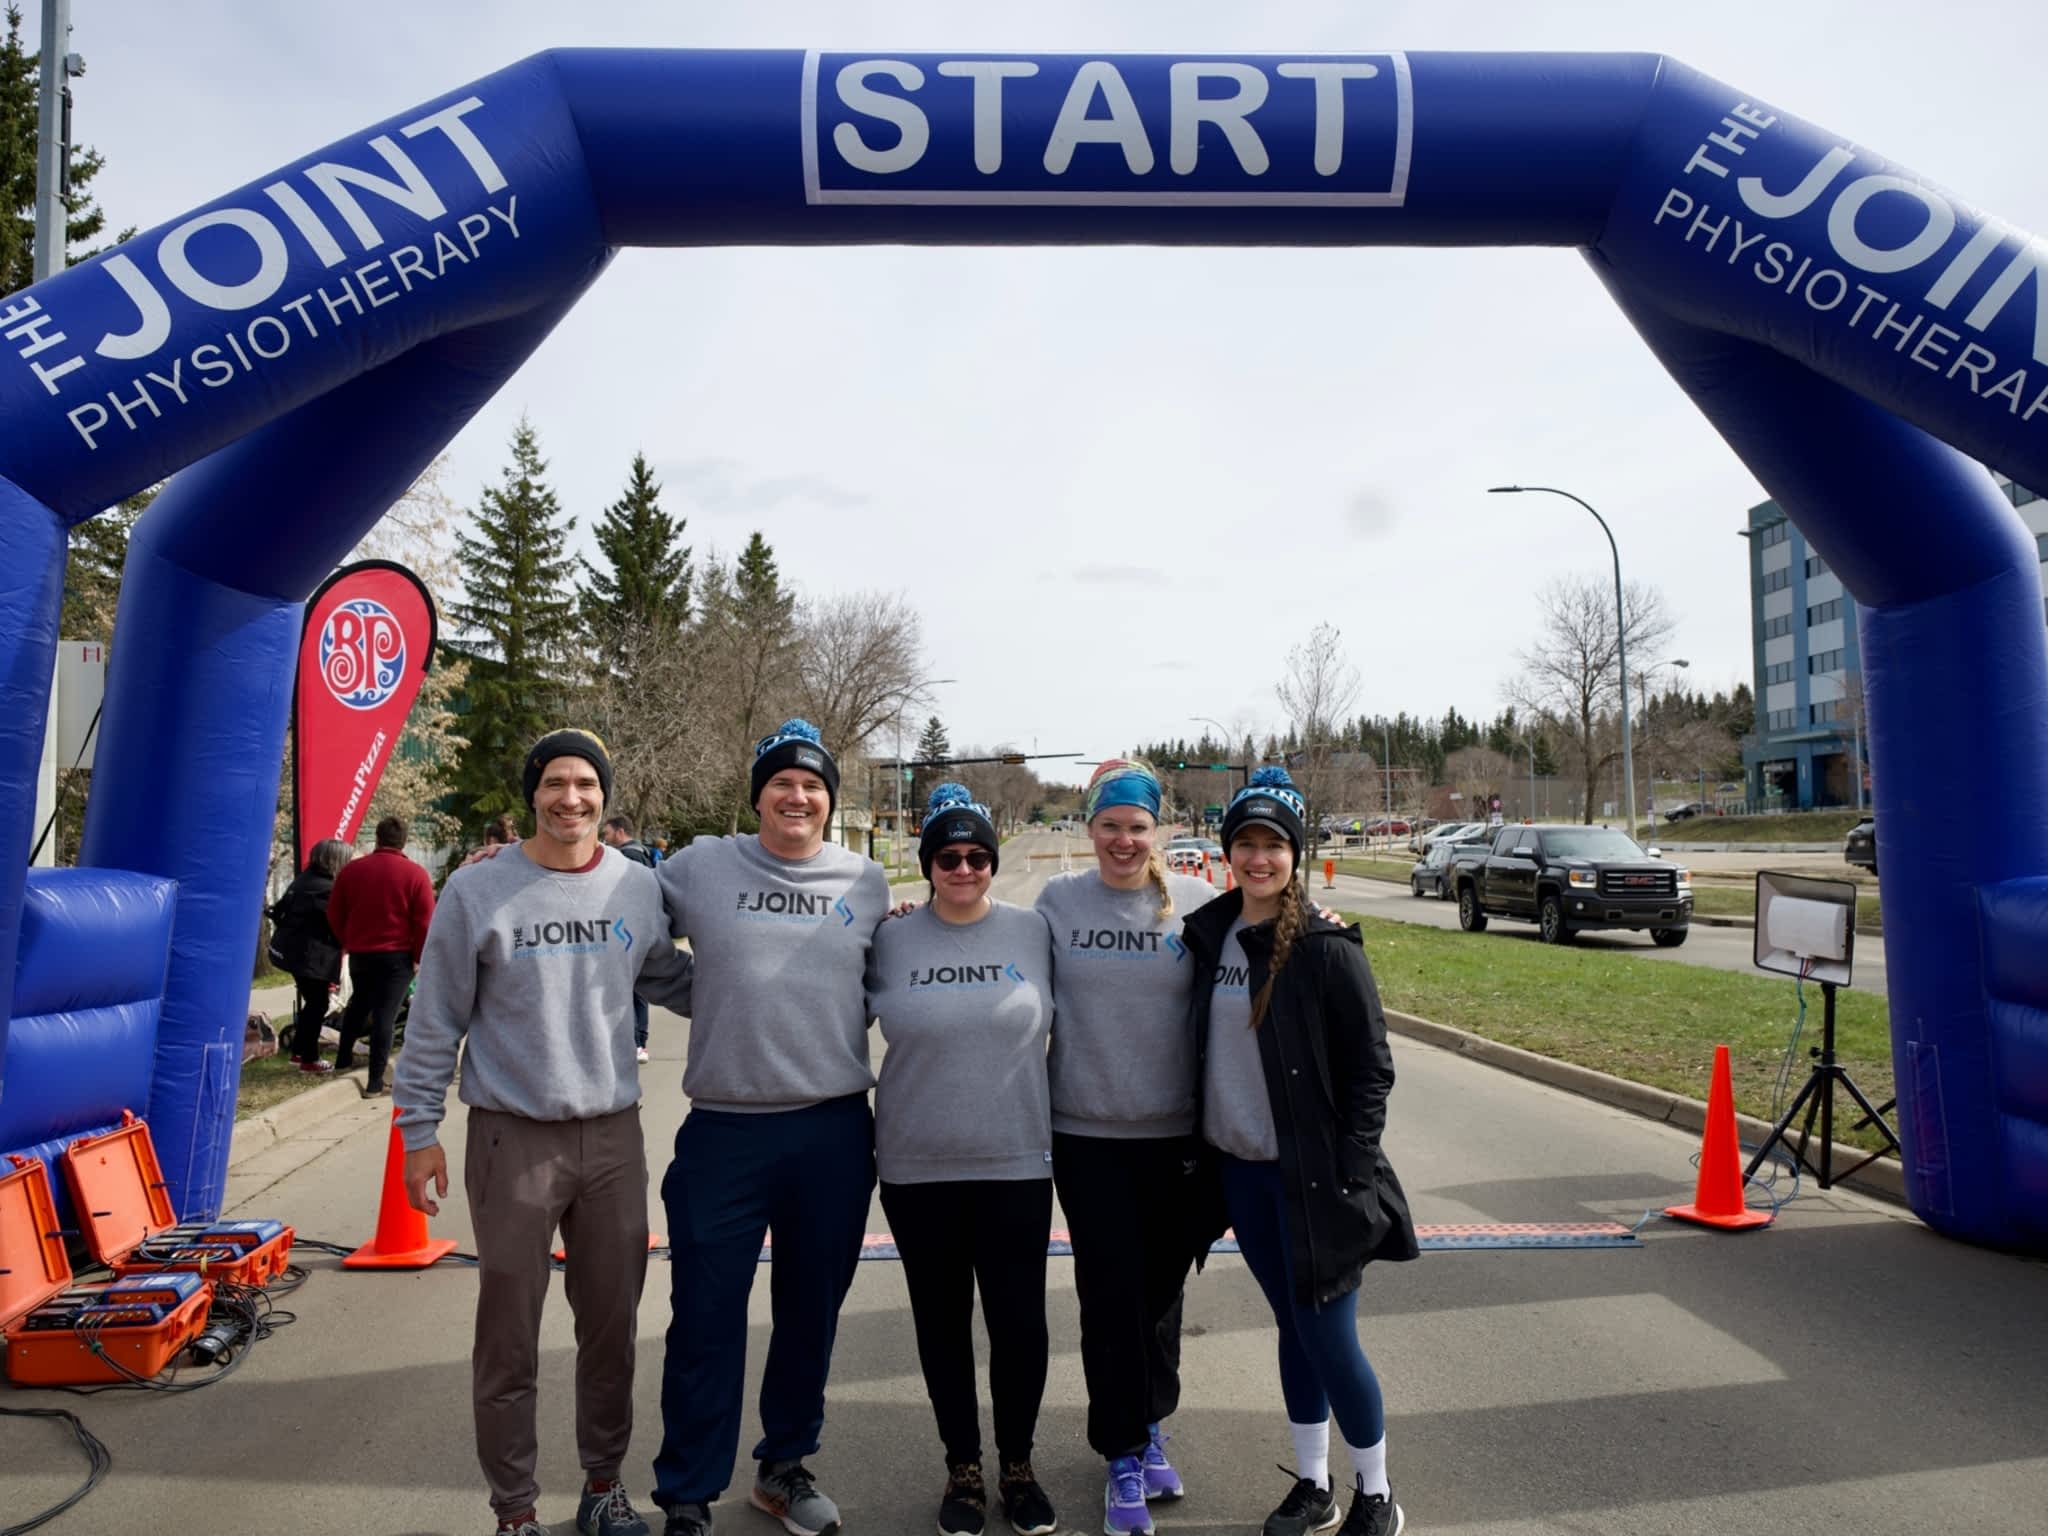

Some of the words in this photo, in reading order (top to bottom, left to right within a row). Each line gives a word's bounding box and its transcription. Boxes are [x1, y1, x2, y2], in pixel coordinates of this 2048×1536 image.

[833, 60, 1379, 176] START
[1684, 103, 1776, 178] THE
[0, 296, 86, 396] THE
[95, 97, 509, 360] JOINT
[67, 196, 520, 450] PHYSIOTHERAPY
[325, 610, 402, 694] BP
[335, 786, 363, 840] oston
[354, 731, 386, 789] Pizza
[513, 927, 523, 949] THE
[525, 920, 611, 947] JOINT
[737, 892, 748, 910] THE
[748, 892, 832, 915] JOINT
[1071, 928, 1080, 948] THE
[1079, 930, 1162, 951] JOINT
[919, 965, 1002, 985] JOINT
[1214, 966, 1249, 986] OIN
